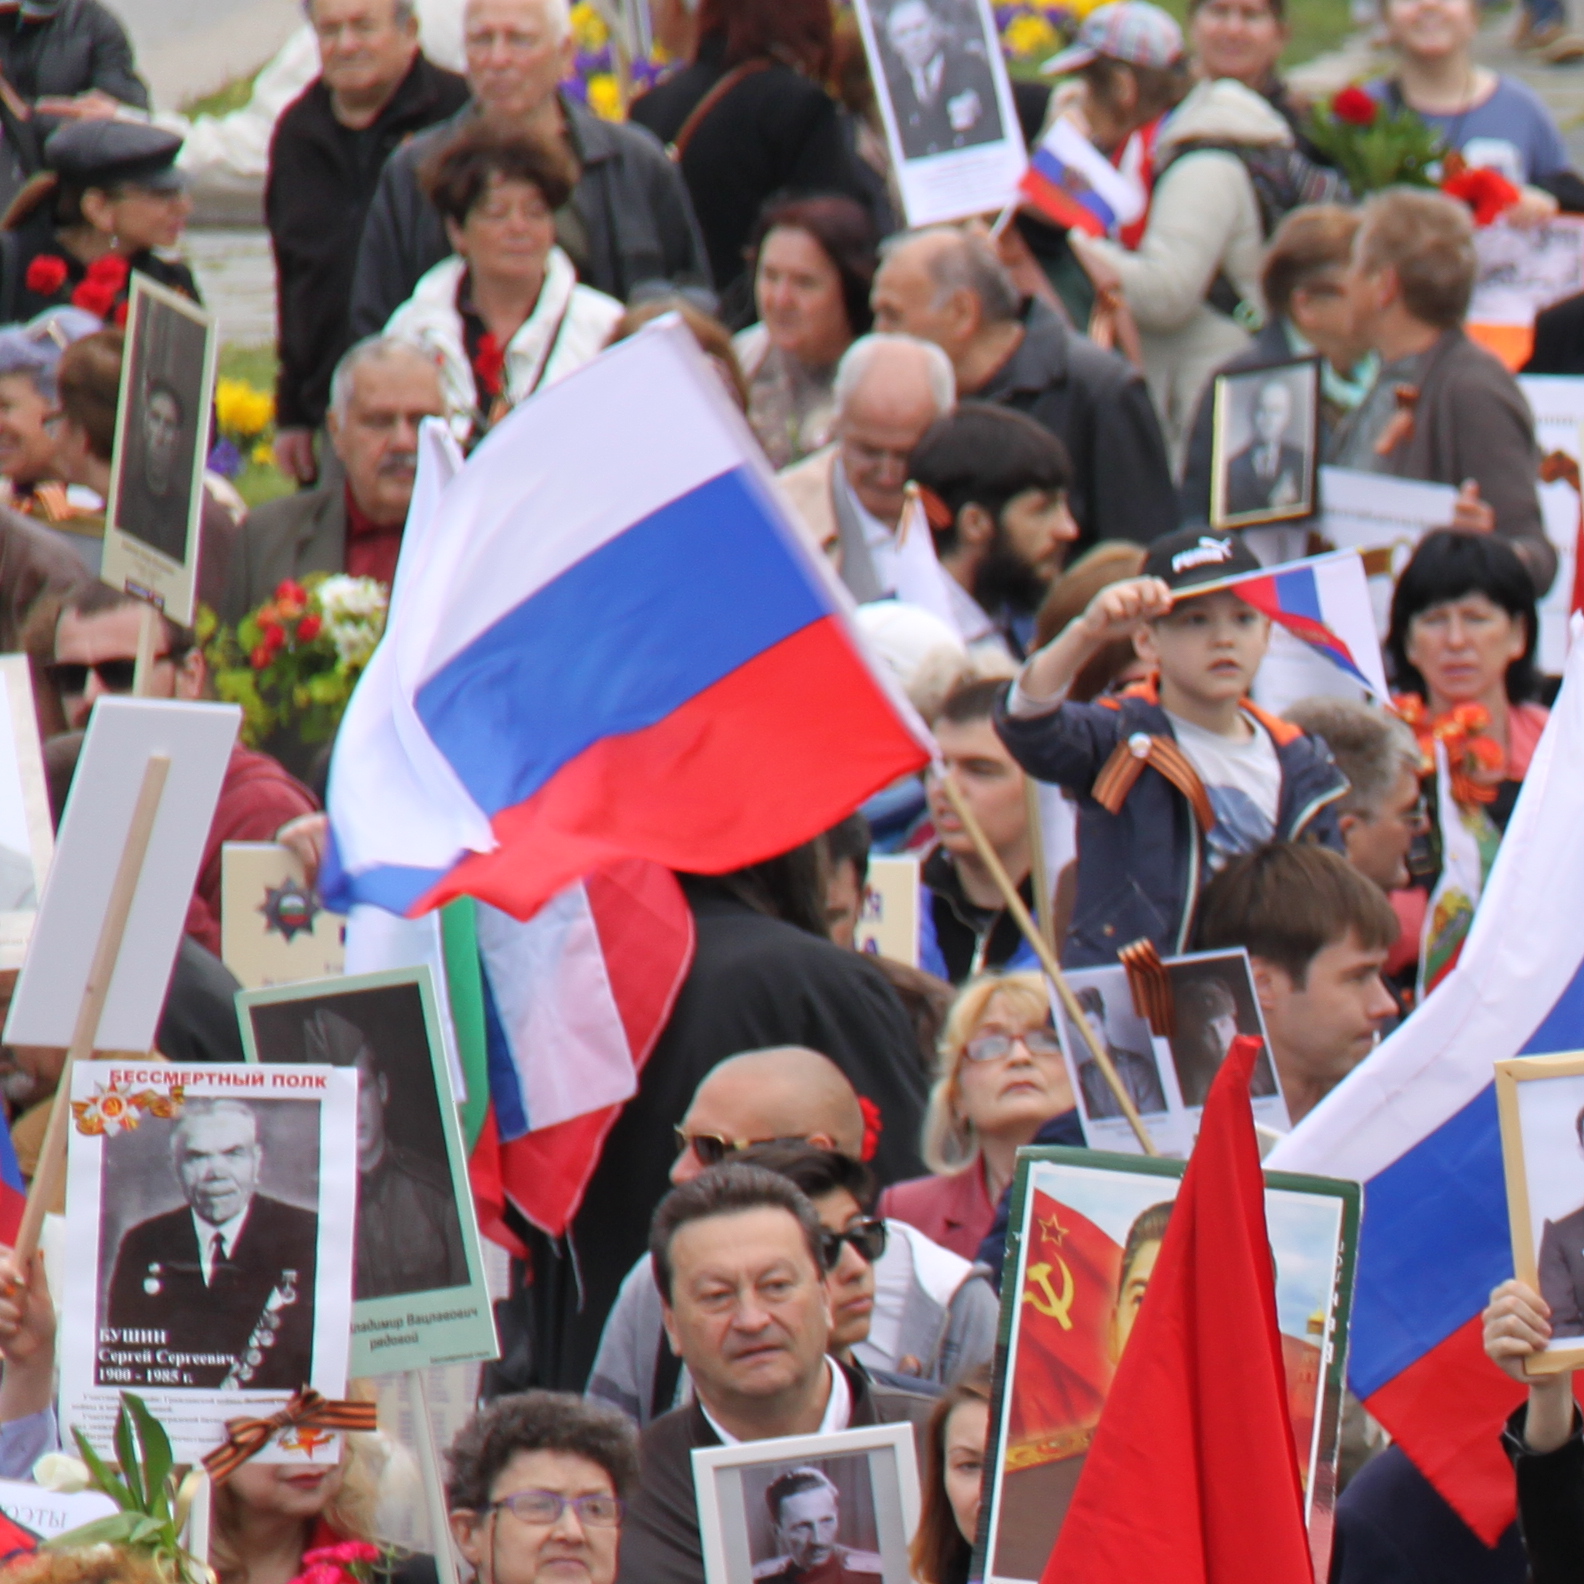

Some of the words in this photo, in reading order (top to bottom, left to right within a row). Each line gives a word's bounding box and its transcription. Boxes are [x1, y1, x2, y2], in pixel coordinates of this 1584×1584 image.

[109, 1069, 264, 1088] БЕССМЕРТНЫЙ
[271, 1073, 327, 1089] ПОЛК
[351, 1316, 404, 1334] ладимир
[100, 1327, 168, 1344] БУШИН
[98, 1350, 152, 1366] Сергей
[156, 1350, 236, 1367] Сергеевич
[99, 1368, 131, 1383] 1900
[146, 1369, 179, 1384] 1985
